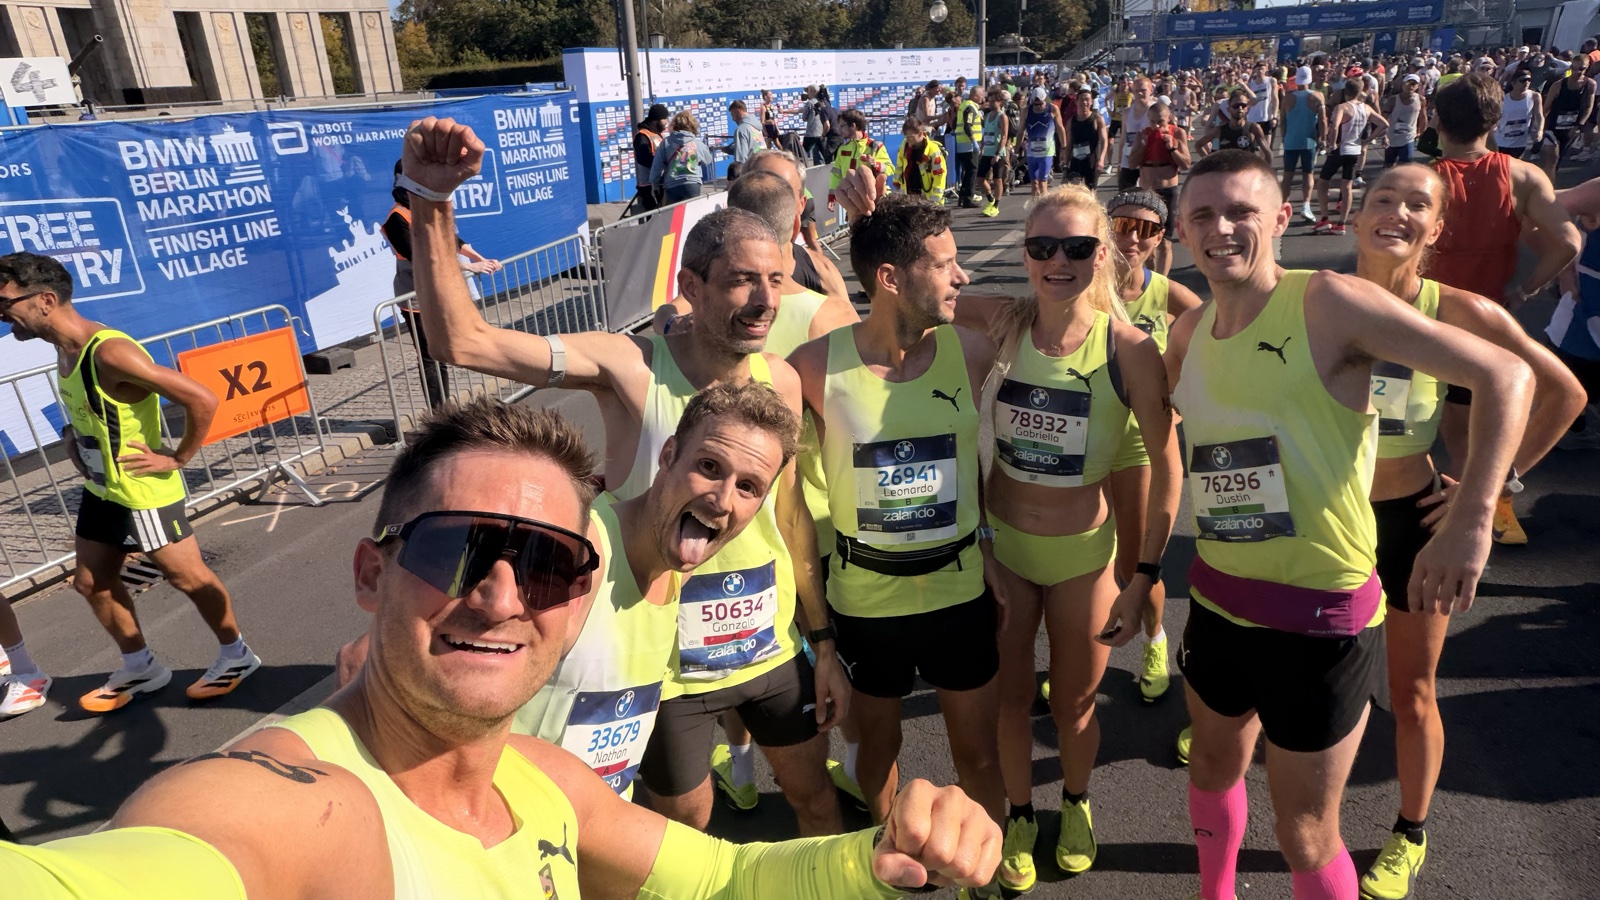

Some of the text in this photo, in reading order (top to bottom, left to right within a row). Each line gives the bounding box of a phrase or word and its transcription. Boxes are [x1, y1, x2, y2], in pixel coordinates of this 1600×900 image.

[10, 62, 58, 103] 4
[311, 121, 353, 135] ABBOTT
[493, 107, 538, 131] BMW
[312, 128, 408, 147] WORLD MARATHO
[498, 129, 541, 148] BERLIN
[118, 136, 209, 171] BMW
[501, 142, 567, 166] MARATHON
[129, 167, 220, 196] BERLIN
[506, 166, 570, 191] FINISH LINE
[136, 184, 272, 221] MARATHON
[509, 186, 554, 207] VILLAGE
[148, 217, 282, 259] FINISH LINE
[157, 247, 248, 282] VILLAGE
[218, 360, 272, 402] X2
[1371, 379, 1387, 396] 2
[1010, 408, 1068, 434] 78932
[1015, 426, 1060, 443] Gabriella
[1032, 441, 1039, 449] B
[1013, 448, 1060, 465] zalando
[877, 463, 937, 487] 26941
[1200, 471, 1261, 493] 76296
[883, 483, 934, 497] Leonardo
[1216, 492, 1251, 505] Dustin
[905, 498, 912, 506] B
[1232, 505, 1239, 514] B
[883, 507, 936, 522] zalando
[1214, 516, 1264, 531] zalando
[701, 595, 764, 622] 50634
[712, 617, 756, 633] Gonzalo
[707, 638, 757, 660] zalando
[587, 720, 641, 753] 33679
[593, 747, 628, 765] Nathan
[603, 765, 610, 775] A
